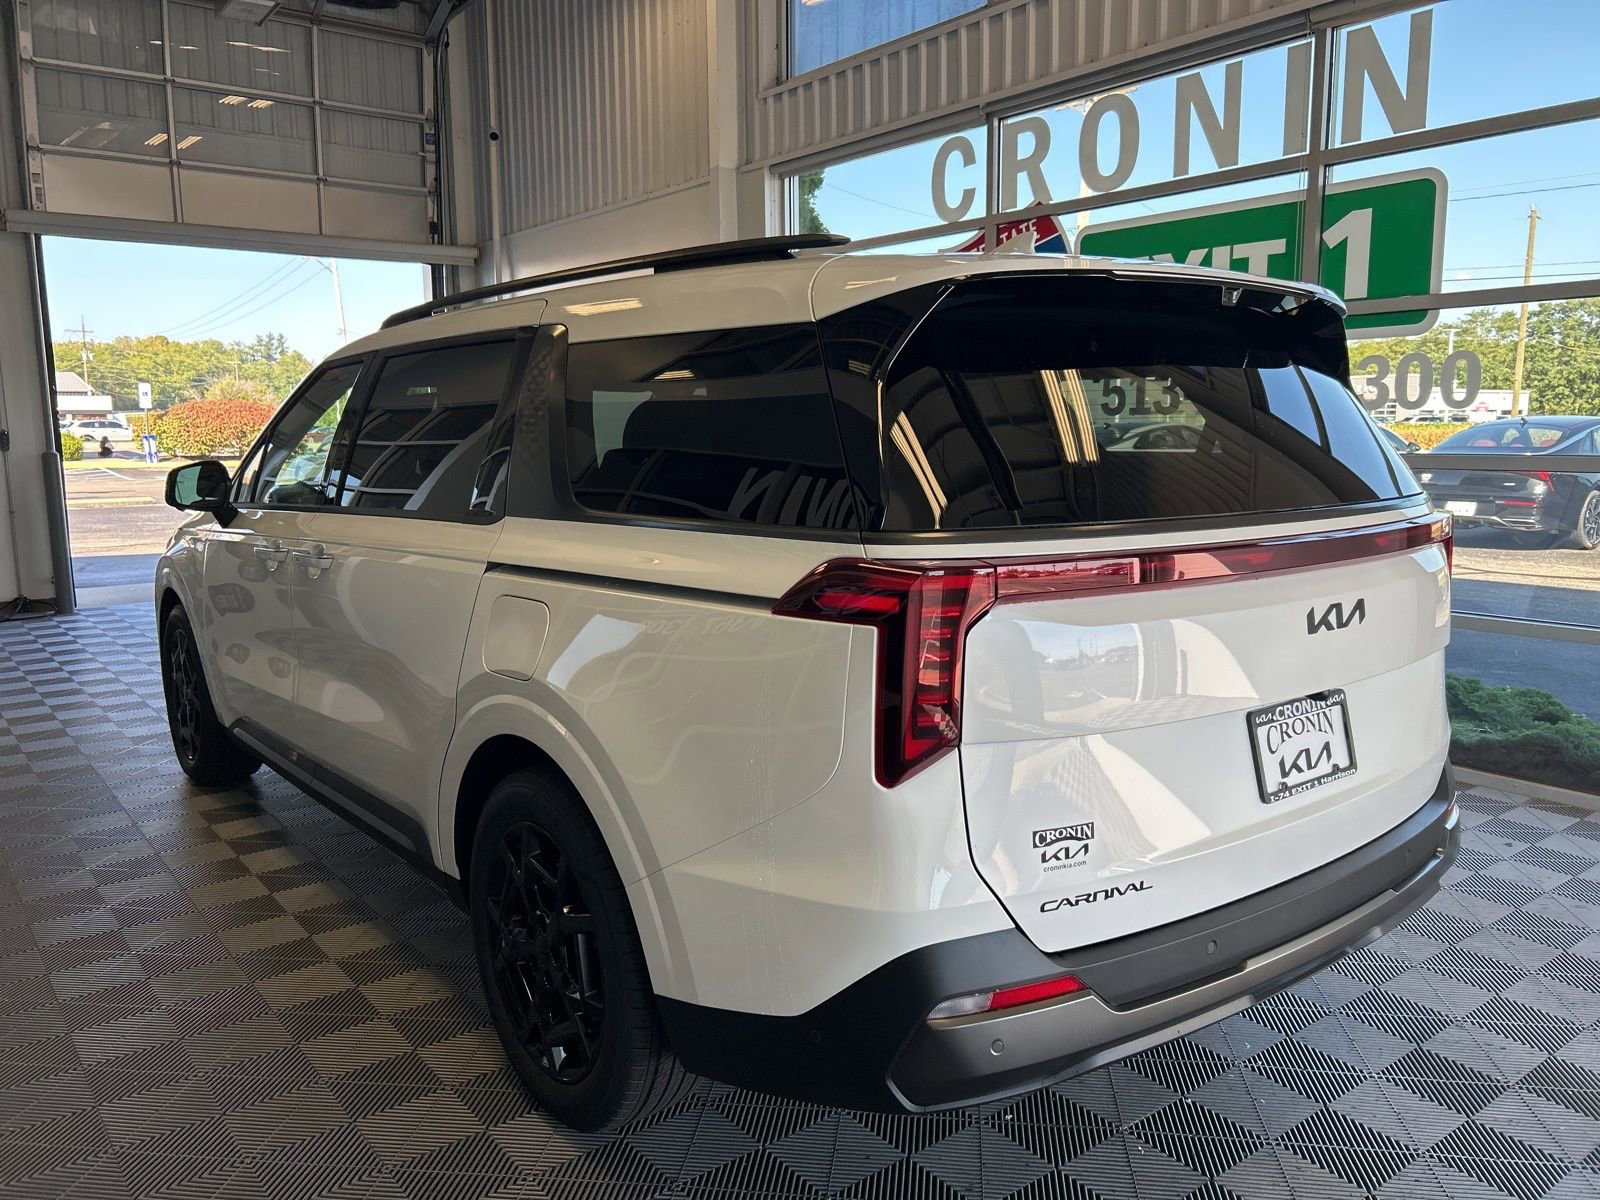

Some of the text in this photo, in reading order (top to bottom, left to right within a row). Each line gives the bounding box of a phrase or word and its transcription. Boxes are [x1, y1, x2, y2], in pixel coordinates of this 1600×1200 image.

[931, 9, 1433, 222] CRONIN
[1322, 207, 1373, 300] 1
[1307, 598, 1366, 635] KIA
[1275, 698, 1327, 721] CRONIN
[1266, 709, 1335, 755] CRONIN
[1279, 741, 1332, 779] KIA
[1291, 783, 1313, 795] EXIT
[1321, 768, 1356, 784] Harrison
[1034, 823, 1092, 847] CRONIN
[1041, 843, 1089, 863] KIA
[1043, 860, 1087, 872] croninkia.com
[1040, 880, 1154, 913] CARNIVAL
